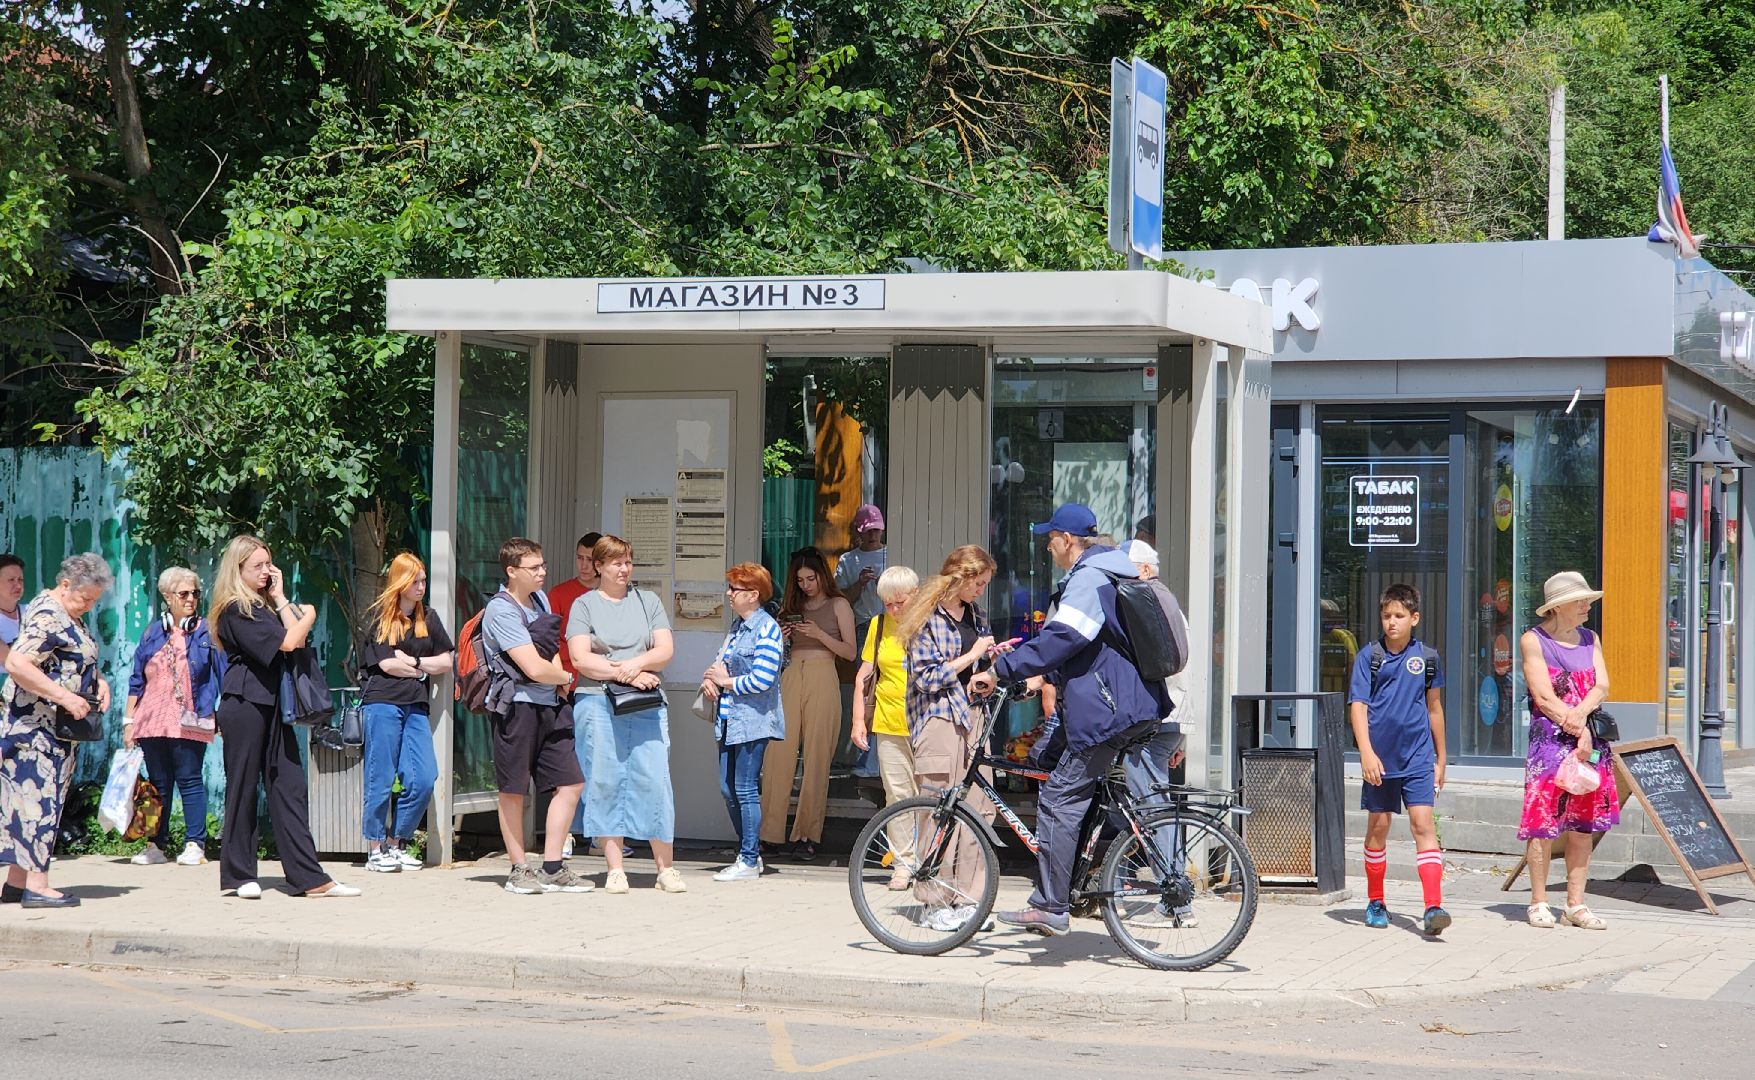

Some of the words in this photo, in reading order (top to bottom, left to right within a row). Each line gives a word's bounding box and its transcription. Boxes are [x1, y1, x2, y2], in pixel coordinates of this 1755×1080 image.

[629, 284, 789, 308] МАГАЗИН
[1354, 480, 1414, 495] ТАБАК
[1356, 505, 1411, 515] ЕЖЕДНЕВНО
[1355, 516, 1412, 526] 9:00-22:00
